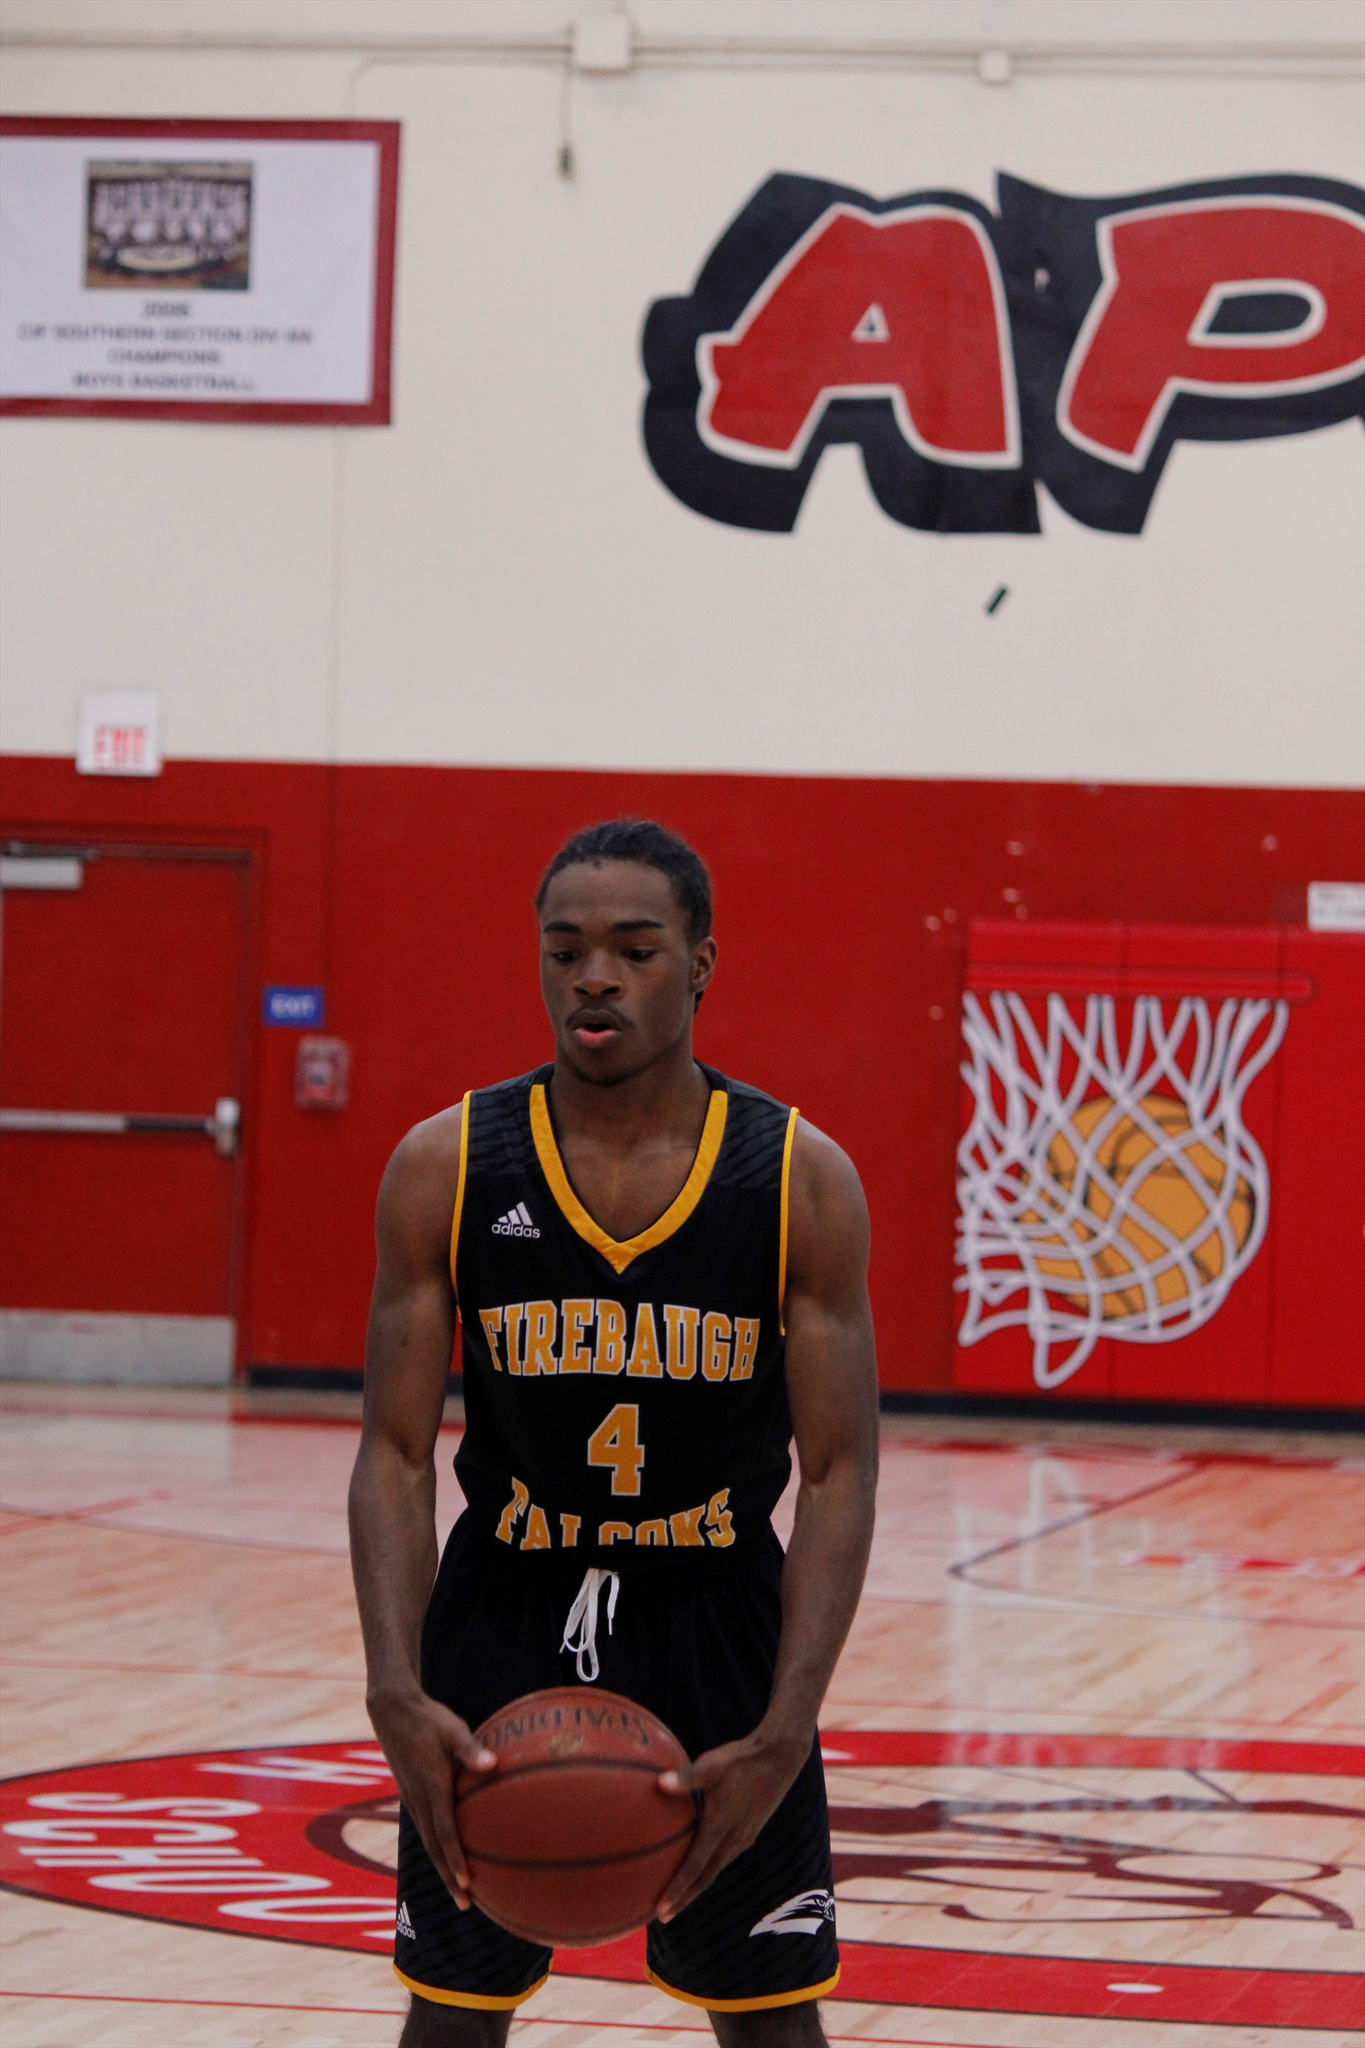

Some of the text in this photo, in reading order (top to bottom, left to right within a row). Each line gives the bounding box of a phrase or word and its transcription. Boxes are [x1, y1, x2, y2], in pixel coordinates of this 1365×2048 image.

[107, 346, 221, 365] CHAMPIONS
[491, 1222, 541, 1239] adidas
[478, 1298, 761, 1382] FIREBAUGH
[586, 1403, 645, 1497] 4
[2, 1791, 398, 1941] SCHOO
